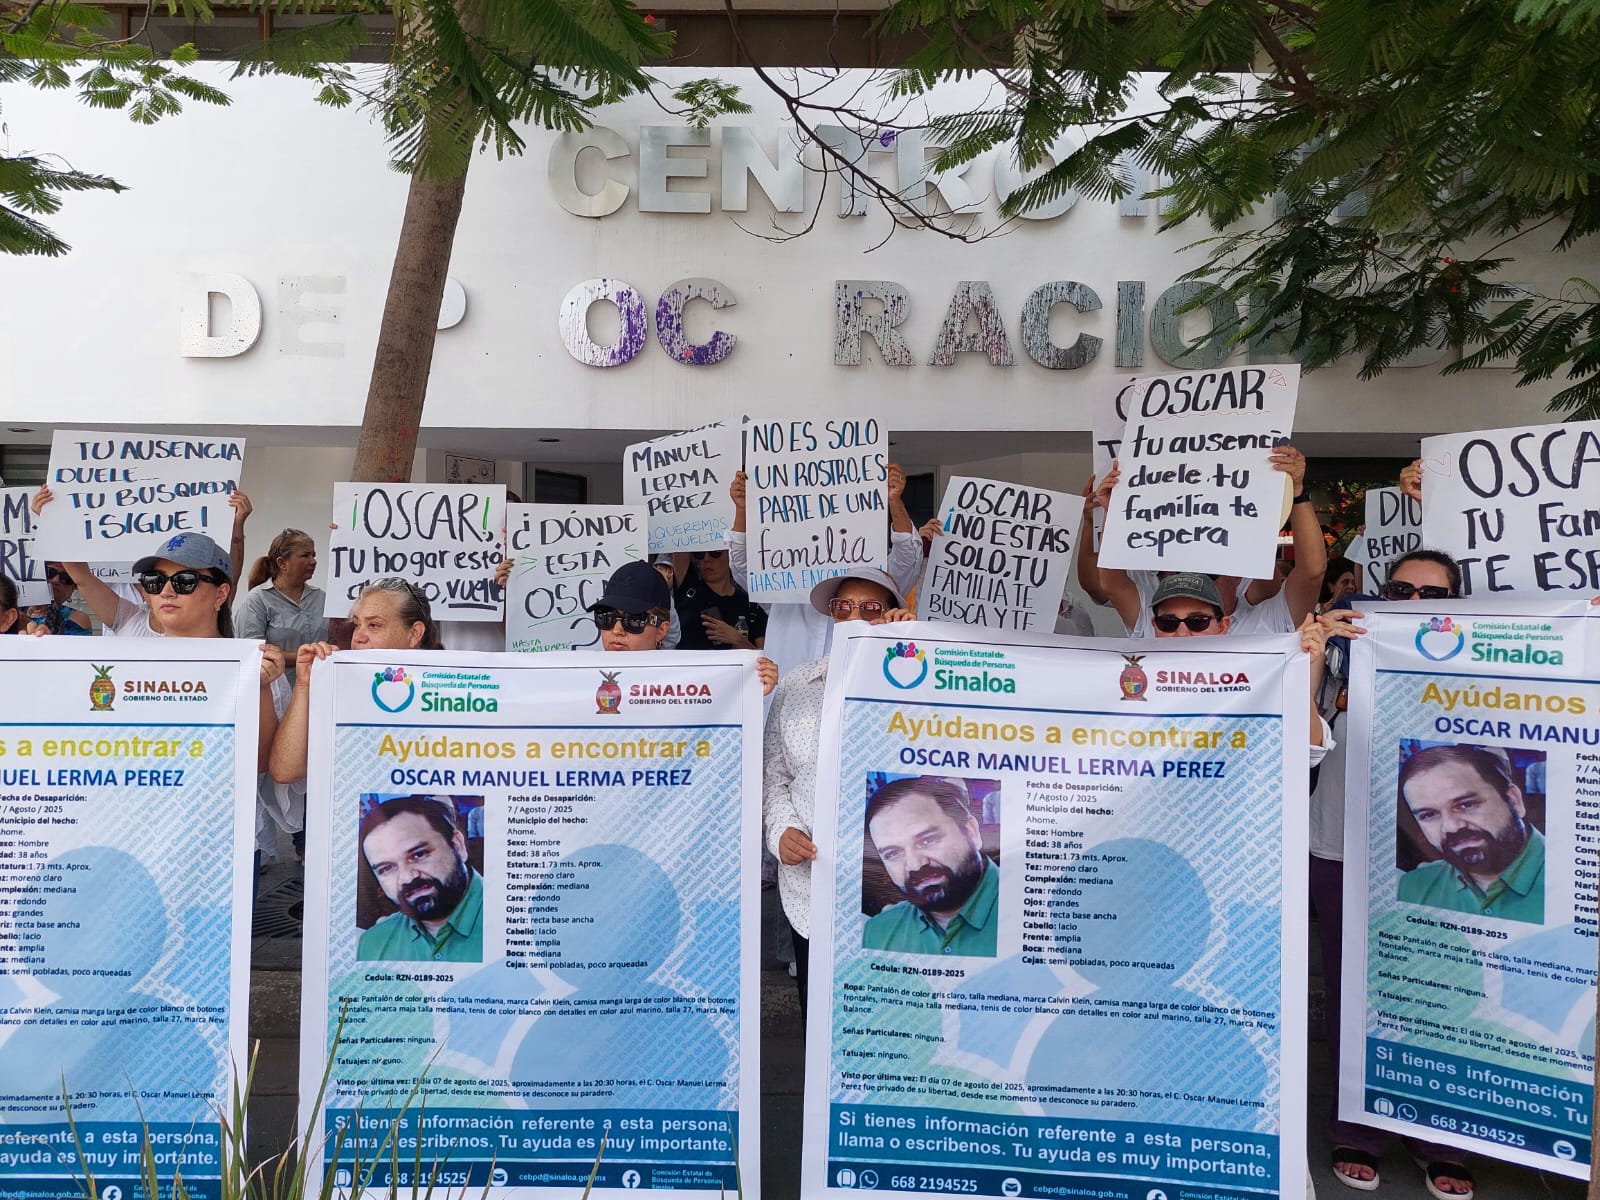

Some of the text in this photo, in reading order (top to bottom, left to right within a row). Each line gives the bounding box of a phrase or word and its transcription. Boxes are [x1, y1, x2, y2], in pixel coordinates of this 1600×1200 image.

[1141, 369, 1266, 417] OSCAR
[754, 422, 784, 453] NO
[790, 421, 817, 451] ES
[826, 418, 879, 449] SOLO
[1133, 425, 1163, 457] tu
[74, 440, 242, 461] TU AUSENCIA
[632, 440, 721, 472] MANUEL
[641, 468, 719, 496] LERMA
[755, 463, 788, 489] UN
[67, 480, 238, 509] TU BUSQUEDA
[759, 488, 885, 523] PARTE DE UNA
[958, 481, 1052, 524] OSCAR
[1122, 494, 1258, 521] familia te
[655, 517, 728, 540] QUEREMOS
[990, 520, 1071, 553] ESTAS
[1463, 508, 1504, 549] TU
[758, 526, 874, 570] familia
[1127, 526, 1229, 557] espera
[332, 546, 365, 578] TU
[373, 546, 450, 577] hogar
[545, 542, 611, 575] ESTÁ
[932, 566, 1037, 609] FAMILIA TE
[1457, 554, 1515, 596] TE
[929, 594, 987, 627] BUSCA
[994, 607, 1008, 628] Y
[1472, 622, 1552, 632] Comisión Estatal de
[1472, 632, 1512, 641] Búsqueda
[1514, 632, 1524, 640] de
[934, 648, 1004, 660] Comisión Estatal de
[934, 658, 1016, 670] Búsqueda de Personas
[1471, 642, 1564, 666] Sinaloa
[123, 680, 207, 693] SINALOA
[421, 680, 454, 690] Búsqueda
[467, 682, 500, 690] Personas
[422, 671, 456, 681] Comisión
[457, 672, 480, 681] Estatal
[934, 669, 1016, 694] Sinaloa
[1156, 670, 1250, 685] SINALOA
[630, 684, 712, 698] SINALOA
[1156, 685, 1198, 693] GOBIERNO
[1218, 685, 1251, 693] ESTADO
[1421, 682, 1586, 714] Ayúdanos
[421, 692, 498, 713] Sinaloa
[887, 711, 1246, 749] Ayúdanos a encontrar a
[1435, 716, 1511, 739] OSCAR
[17, 740, 33, 757] a
[43, 736, 184, 758] encontrar
[189, 740, 204, 757] a
[378, 735, 711, 763] Ayúdanos a encontrar a
[900, 746, 1225, 778] OSCAR MANUEL LERMA PEREZ
[47, 770, 185, 787] LERMA PEREZ
[390, 768, 692, 787] OSCAR MANUEL LERMA PEREZ
[1026, 781, 1123, 793] Fecha de Desaparición:
[1026, 804, 1114, 816] Municipio del hecho:
[1026, 828, 1084, 838] Sexo: Hombre
[1406, 916, 1508, 940] Cedula: RZN-0189-2025
[365, 974, 454, 983] Cedula: RZN-0189-2025
[870, 963, 965, 978] Cedula: RZN-0189-2025
[839, 1111, 1272, 1161] Si tienes información referente a esta persona,
[838, 1132, 1272, 1179] llama o escribenos. Tu ayuda es muy importante.
[890, 1176, 978, 1193] 668 2194525
